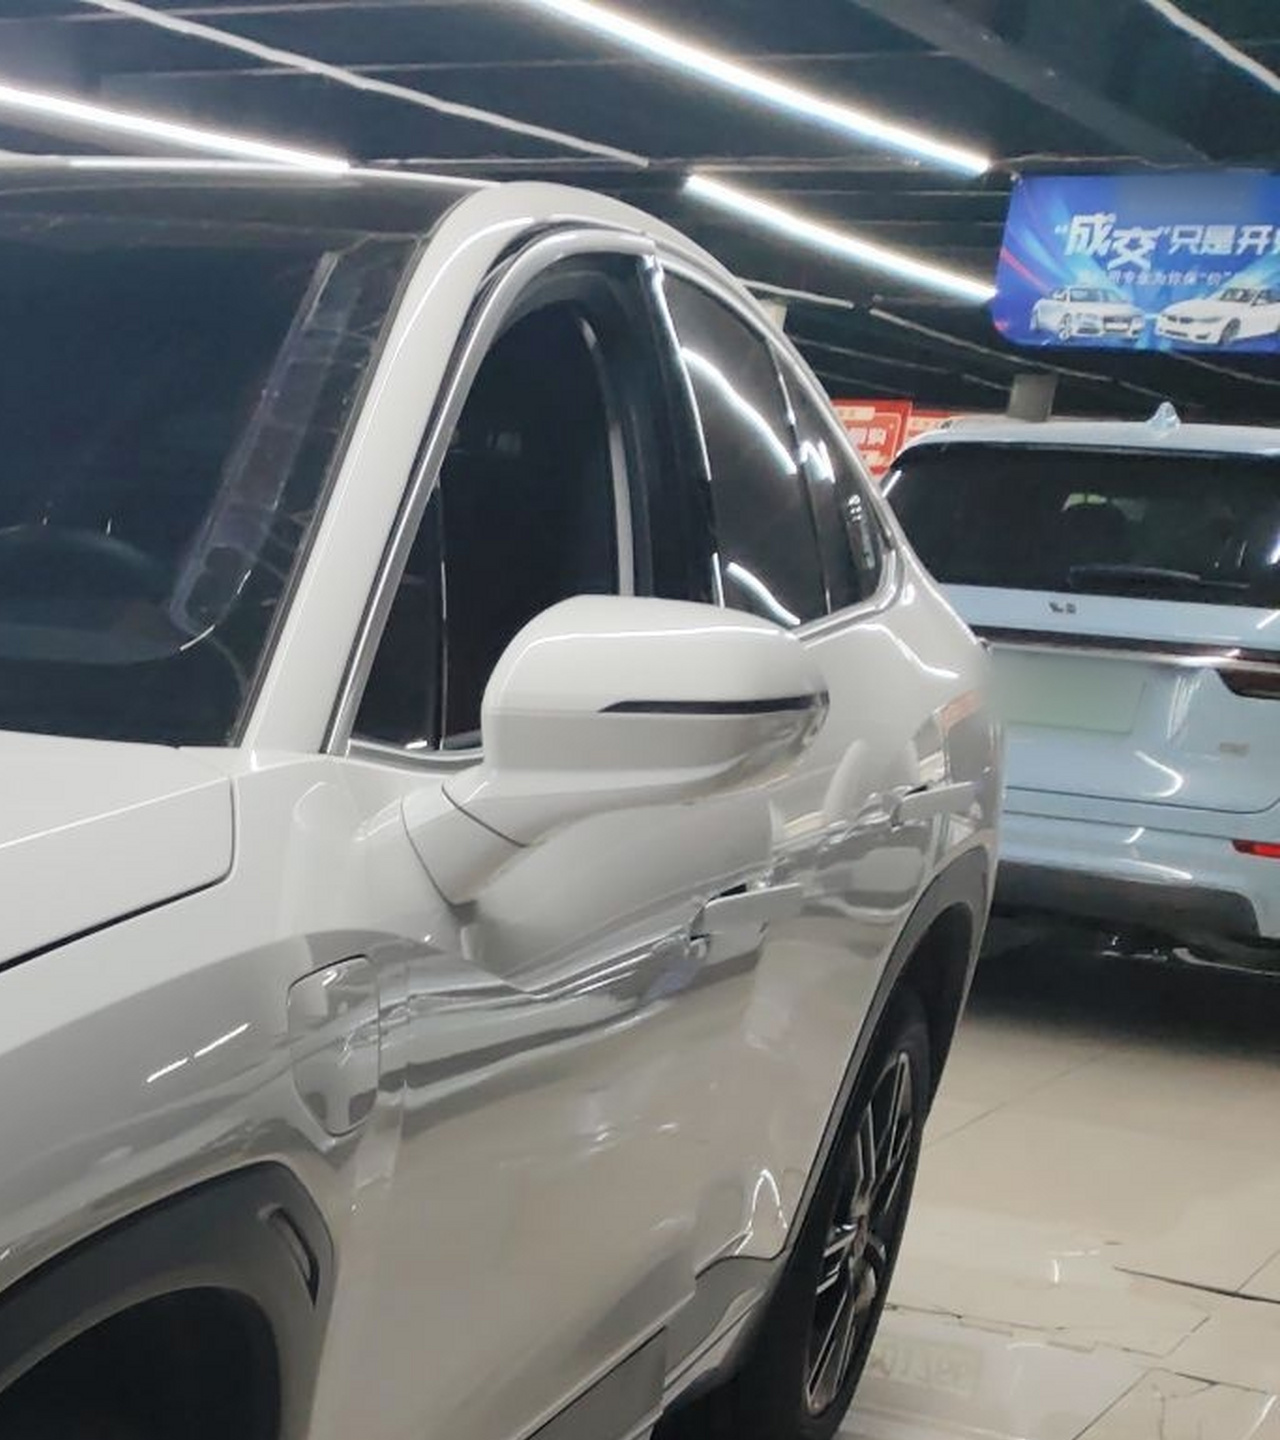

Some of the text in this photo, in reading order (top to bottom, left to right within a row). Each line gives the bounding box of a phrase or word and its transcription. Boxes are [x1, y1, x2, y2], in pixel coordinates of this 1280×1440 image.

[1055, 213, 1280, 271] “成交”只是开
